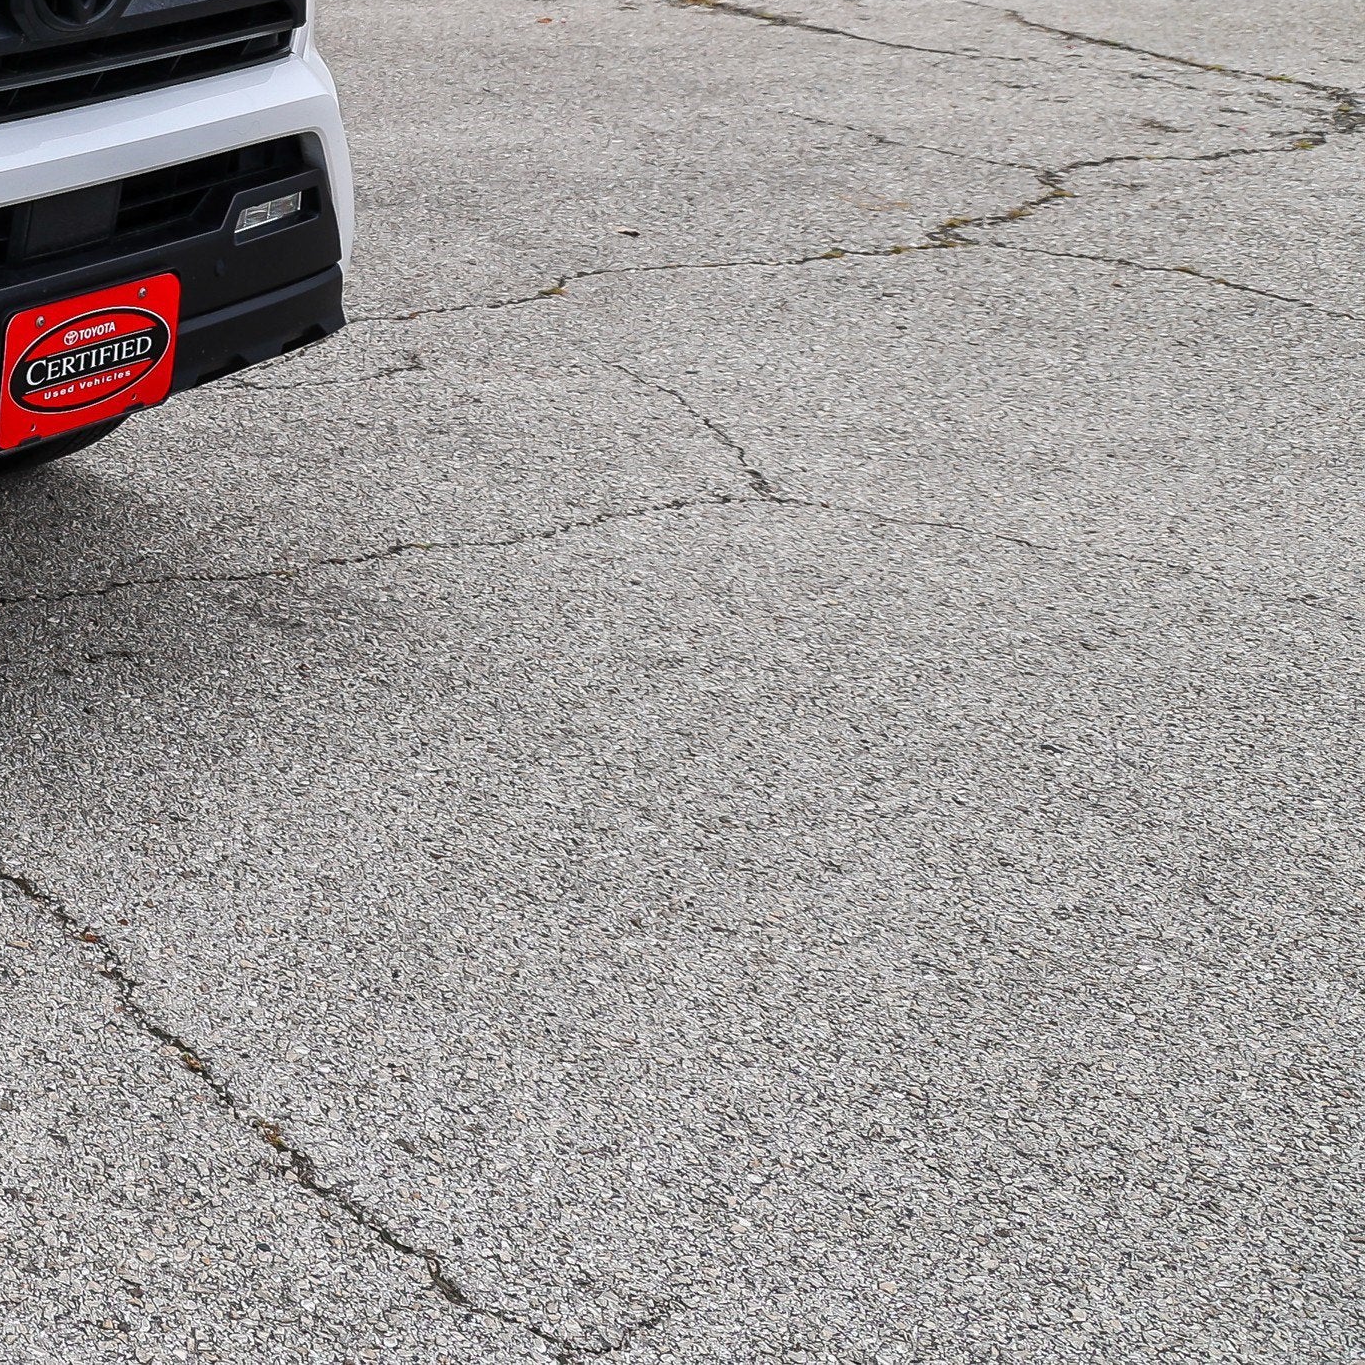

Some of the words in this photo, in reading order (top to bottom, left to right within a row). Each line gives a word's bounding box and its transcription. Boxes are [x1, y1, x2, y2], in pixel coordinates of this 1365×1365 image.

[80, 322, 116, 340] TOYOTA
[44, 385, 74, 400] Used
[80, 370, 131, 390] Vehicles
